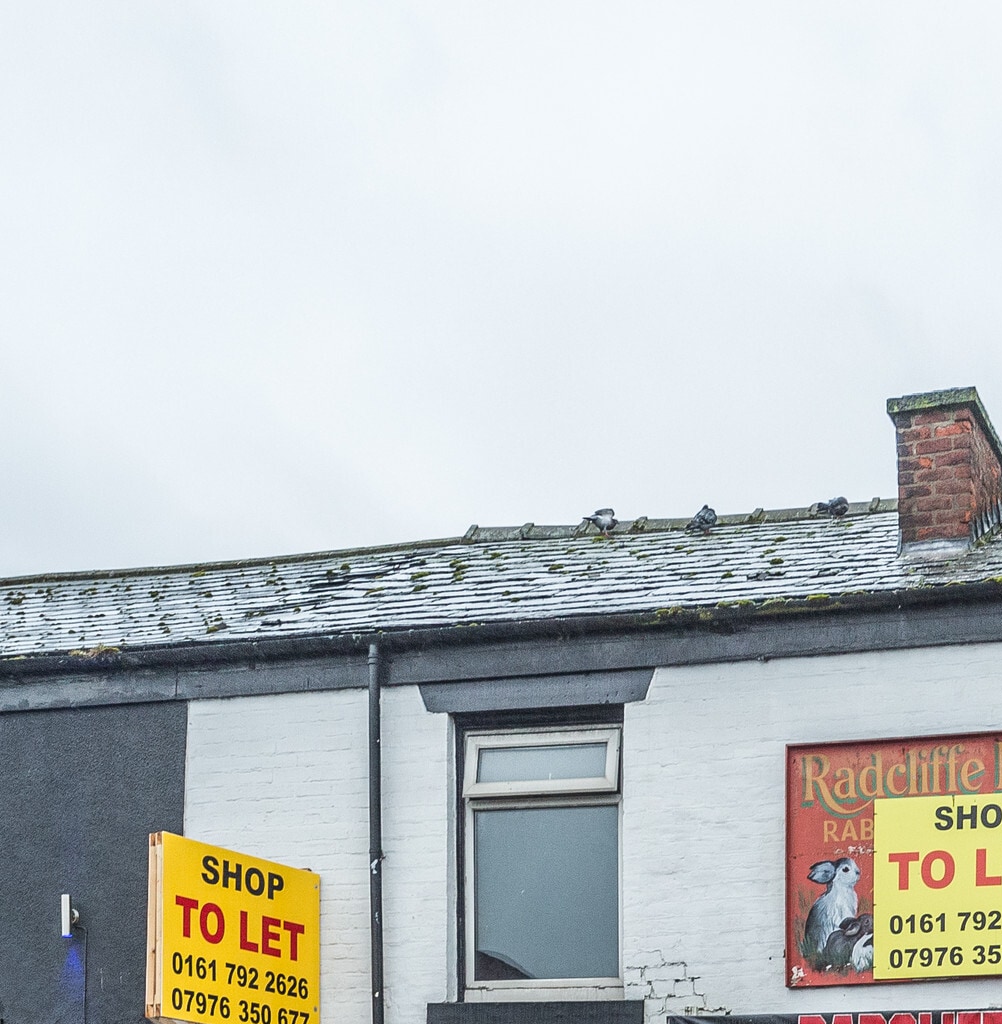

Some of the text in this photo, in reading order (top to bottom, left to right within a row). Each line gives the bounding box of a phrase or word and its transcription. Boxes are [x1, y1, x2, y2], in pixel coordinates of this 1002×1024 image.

[801, 743, 986, 819] Radcliffe
[823, 818, 874, 843] RAB
[201, 855, 285, 900] SHOP
[888, 850, 956, 890] TO
[175, 894, 305, 962] TO LET
[889, 912, 946, 935] 0161
[957, 910, 1002, 931] 792
[172, 951, 309, 1000] 0161 792 2626
[889, 946, 963, 968] 07976
[171, 987, 231, 1019] 07976
